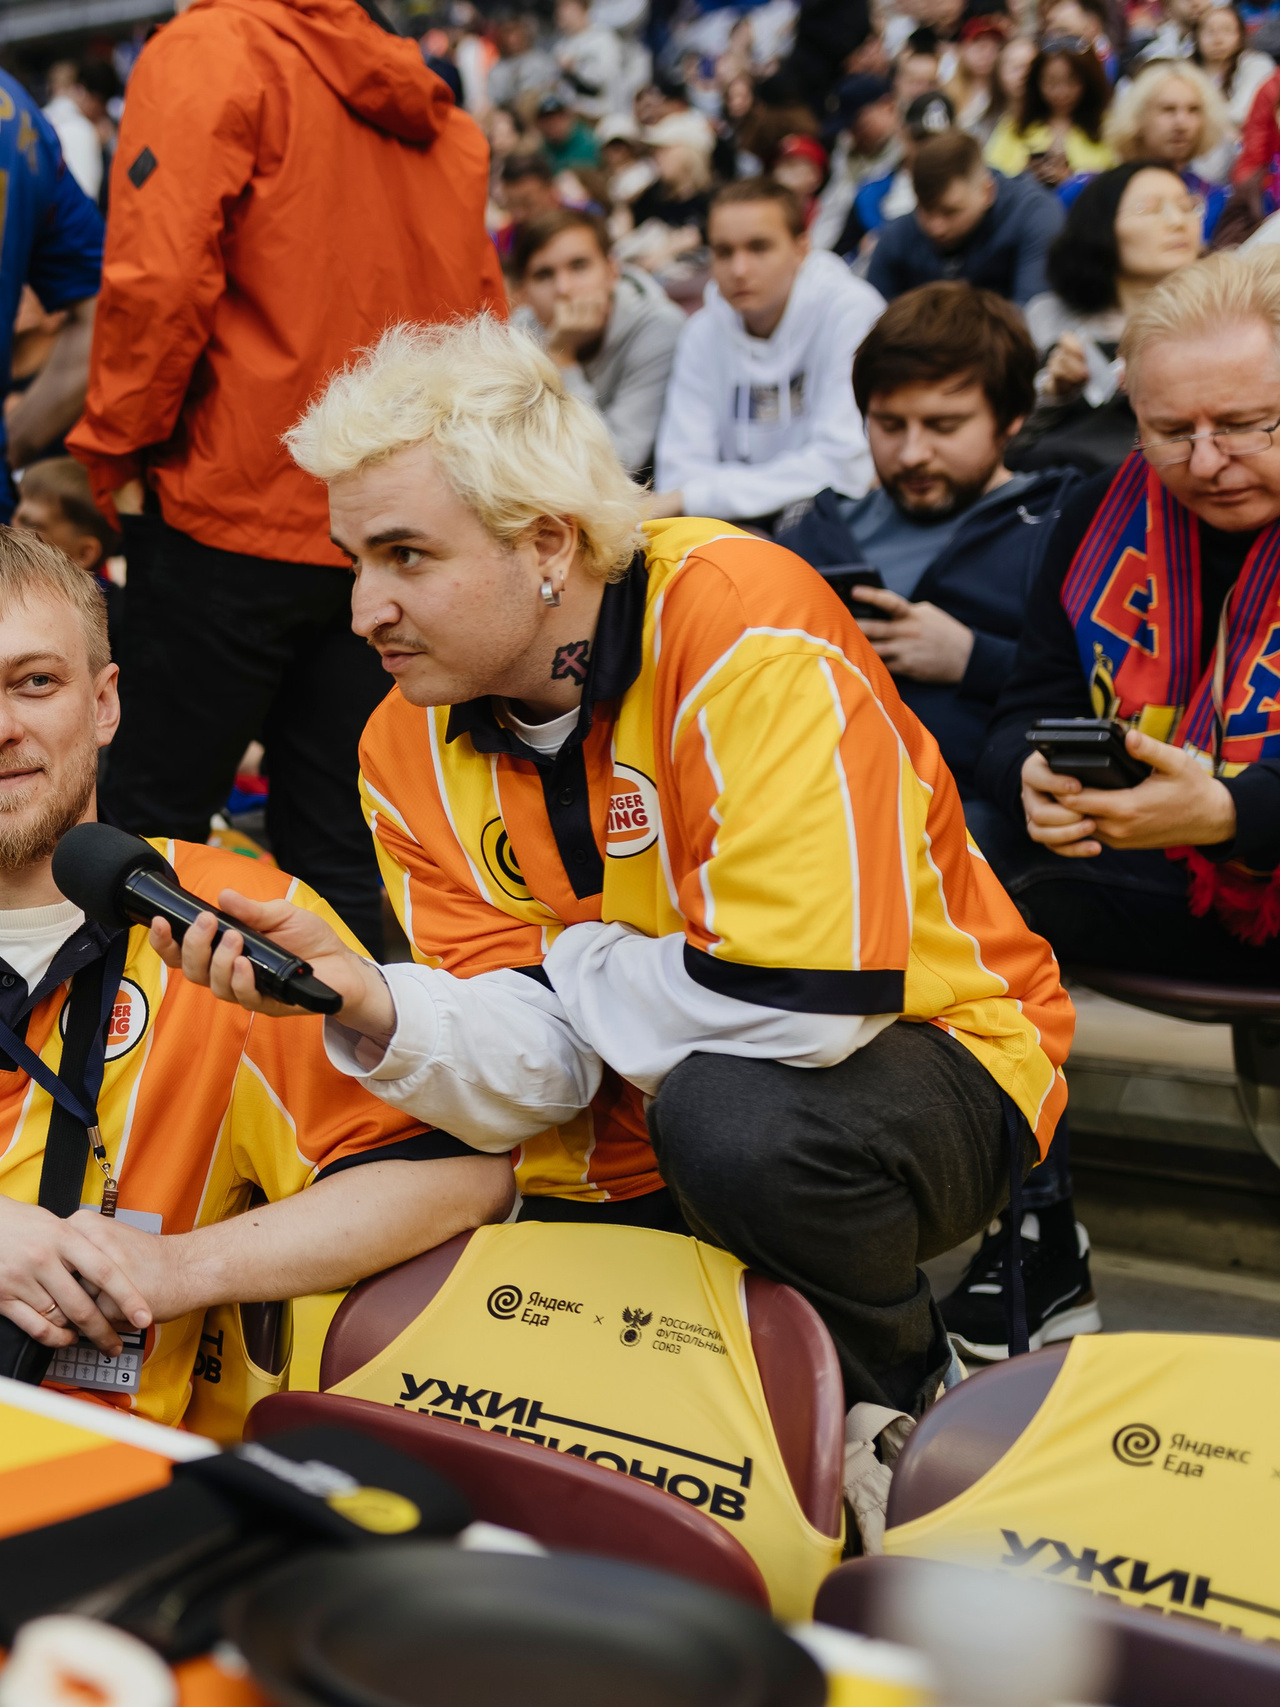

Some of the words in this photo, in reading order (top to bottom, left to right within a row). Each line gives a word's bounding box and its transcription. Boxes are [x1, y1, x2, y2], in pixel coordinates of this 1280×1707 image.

[609, 794, 644, 811] RGER
[608, 808, 648, 831] ING
[527, 1291, 583, 1314] Яндекс
[521, 1308, 550, 1327] Еда
[659, 1316, 723, 1342] РОССИЙСКИ
[652, 1340, 682, 1355] СОЮЗ
[121, 1372, 130, 1383] 9
[1169, 1433, 1252, 1465] Яндекс
[1163, 1453, 1205, 1478] Еда
